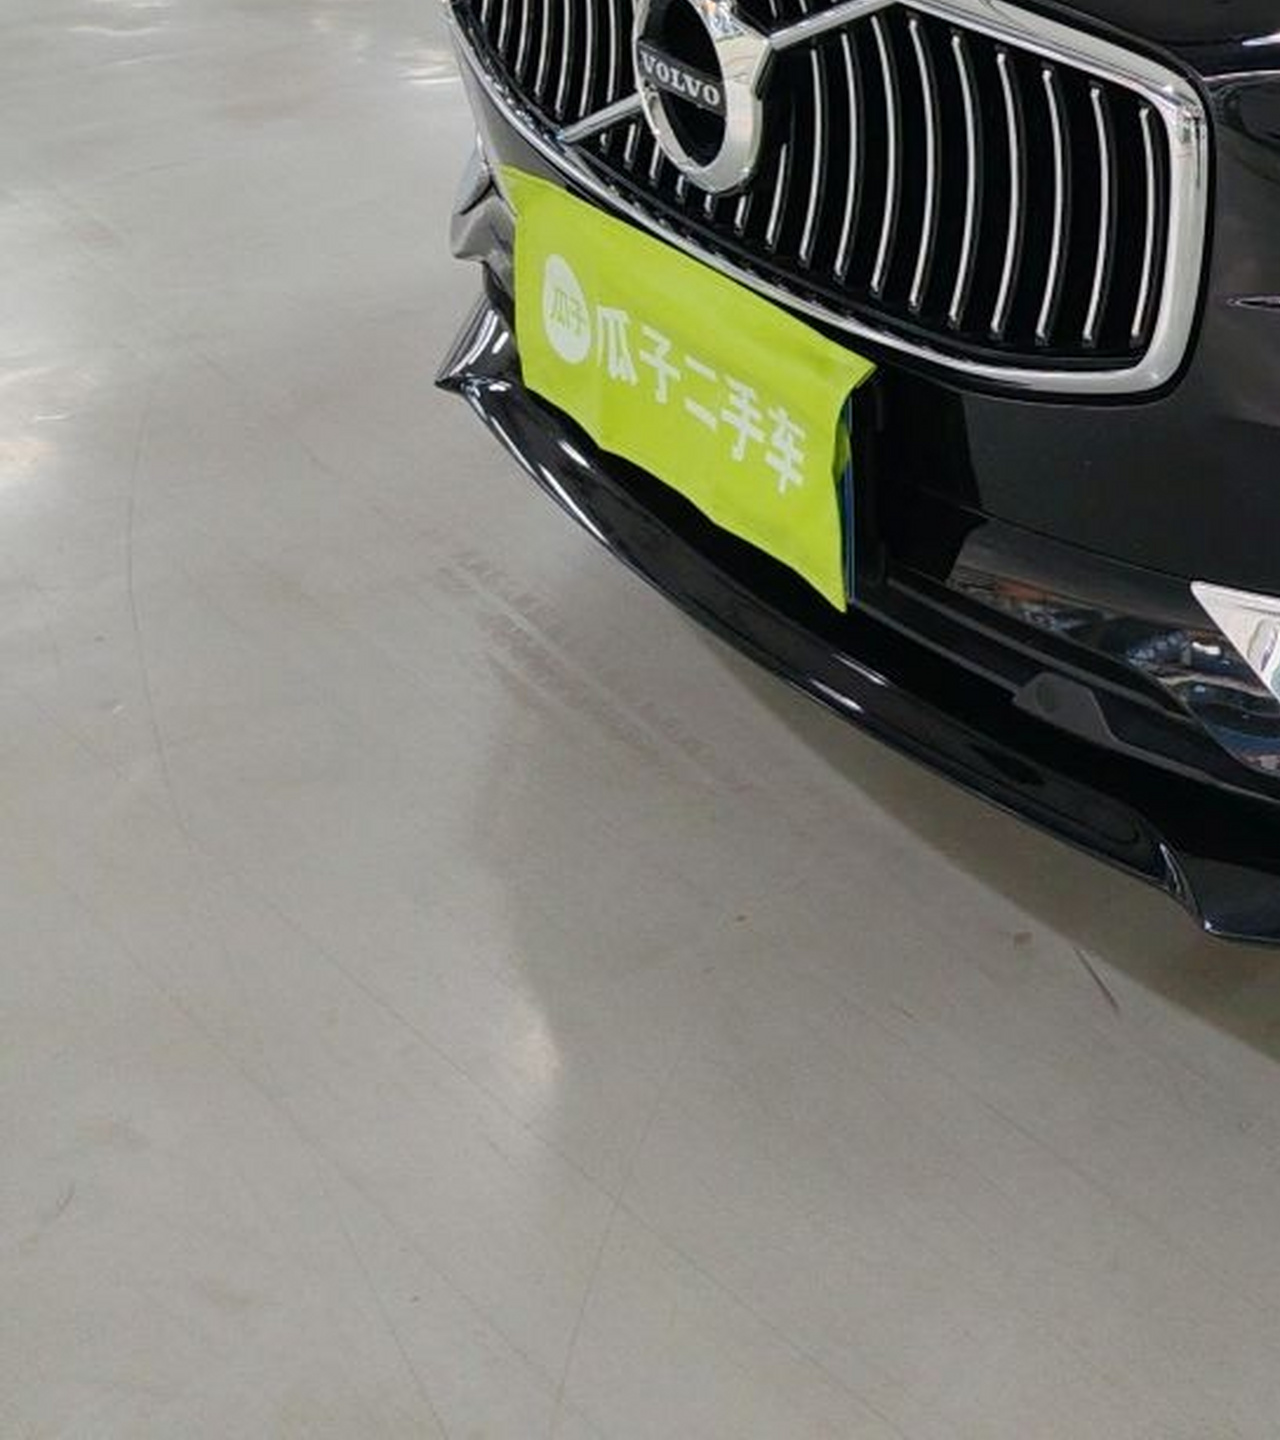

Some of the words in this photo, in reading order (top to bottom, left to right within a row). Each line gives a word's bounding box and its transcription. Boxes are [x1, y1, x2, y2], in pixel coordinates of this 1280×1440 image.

[640, 50, 721, 106] VOLVO
[596, 306, 806, 495] 瓜子二手车
